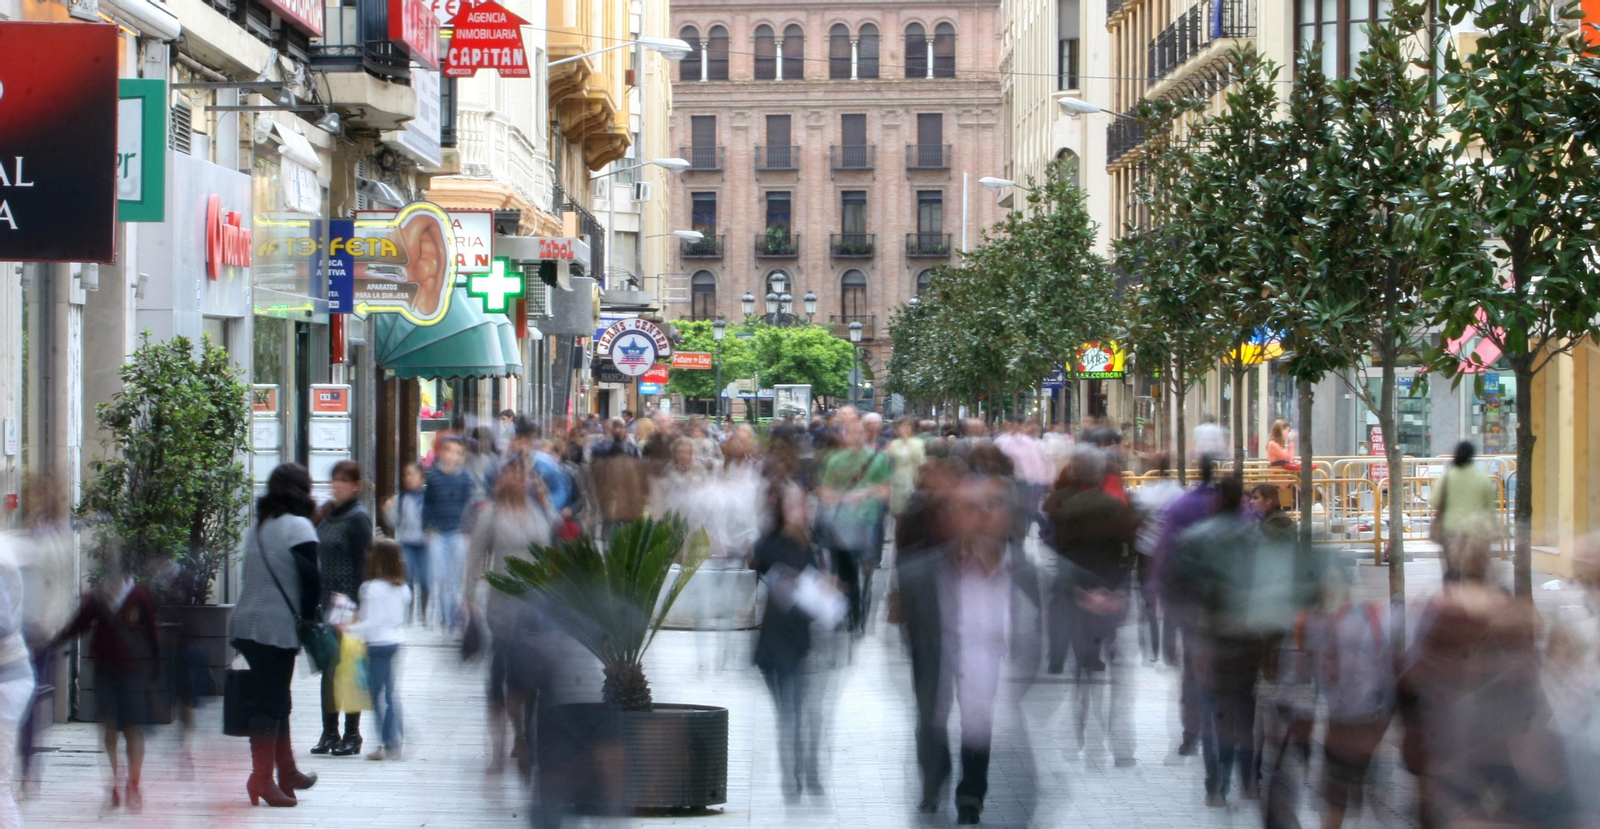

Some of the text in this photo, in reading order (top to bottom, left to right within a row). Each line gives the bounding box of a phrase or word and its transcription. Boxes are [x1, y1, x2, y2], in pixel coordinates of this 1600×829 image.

[467, 12, 507, 23] AGENCIA
[456, 28, 518, 39] INMOBILIARIA
[367, 283, 398, 291] APARATOS
[600, 319, 668, 351] JEANS CENTER
